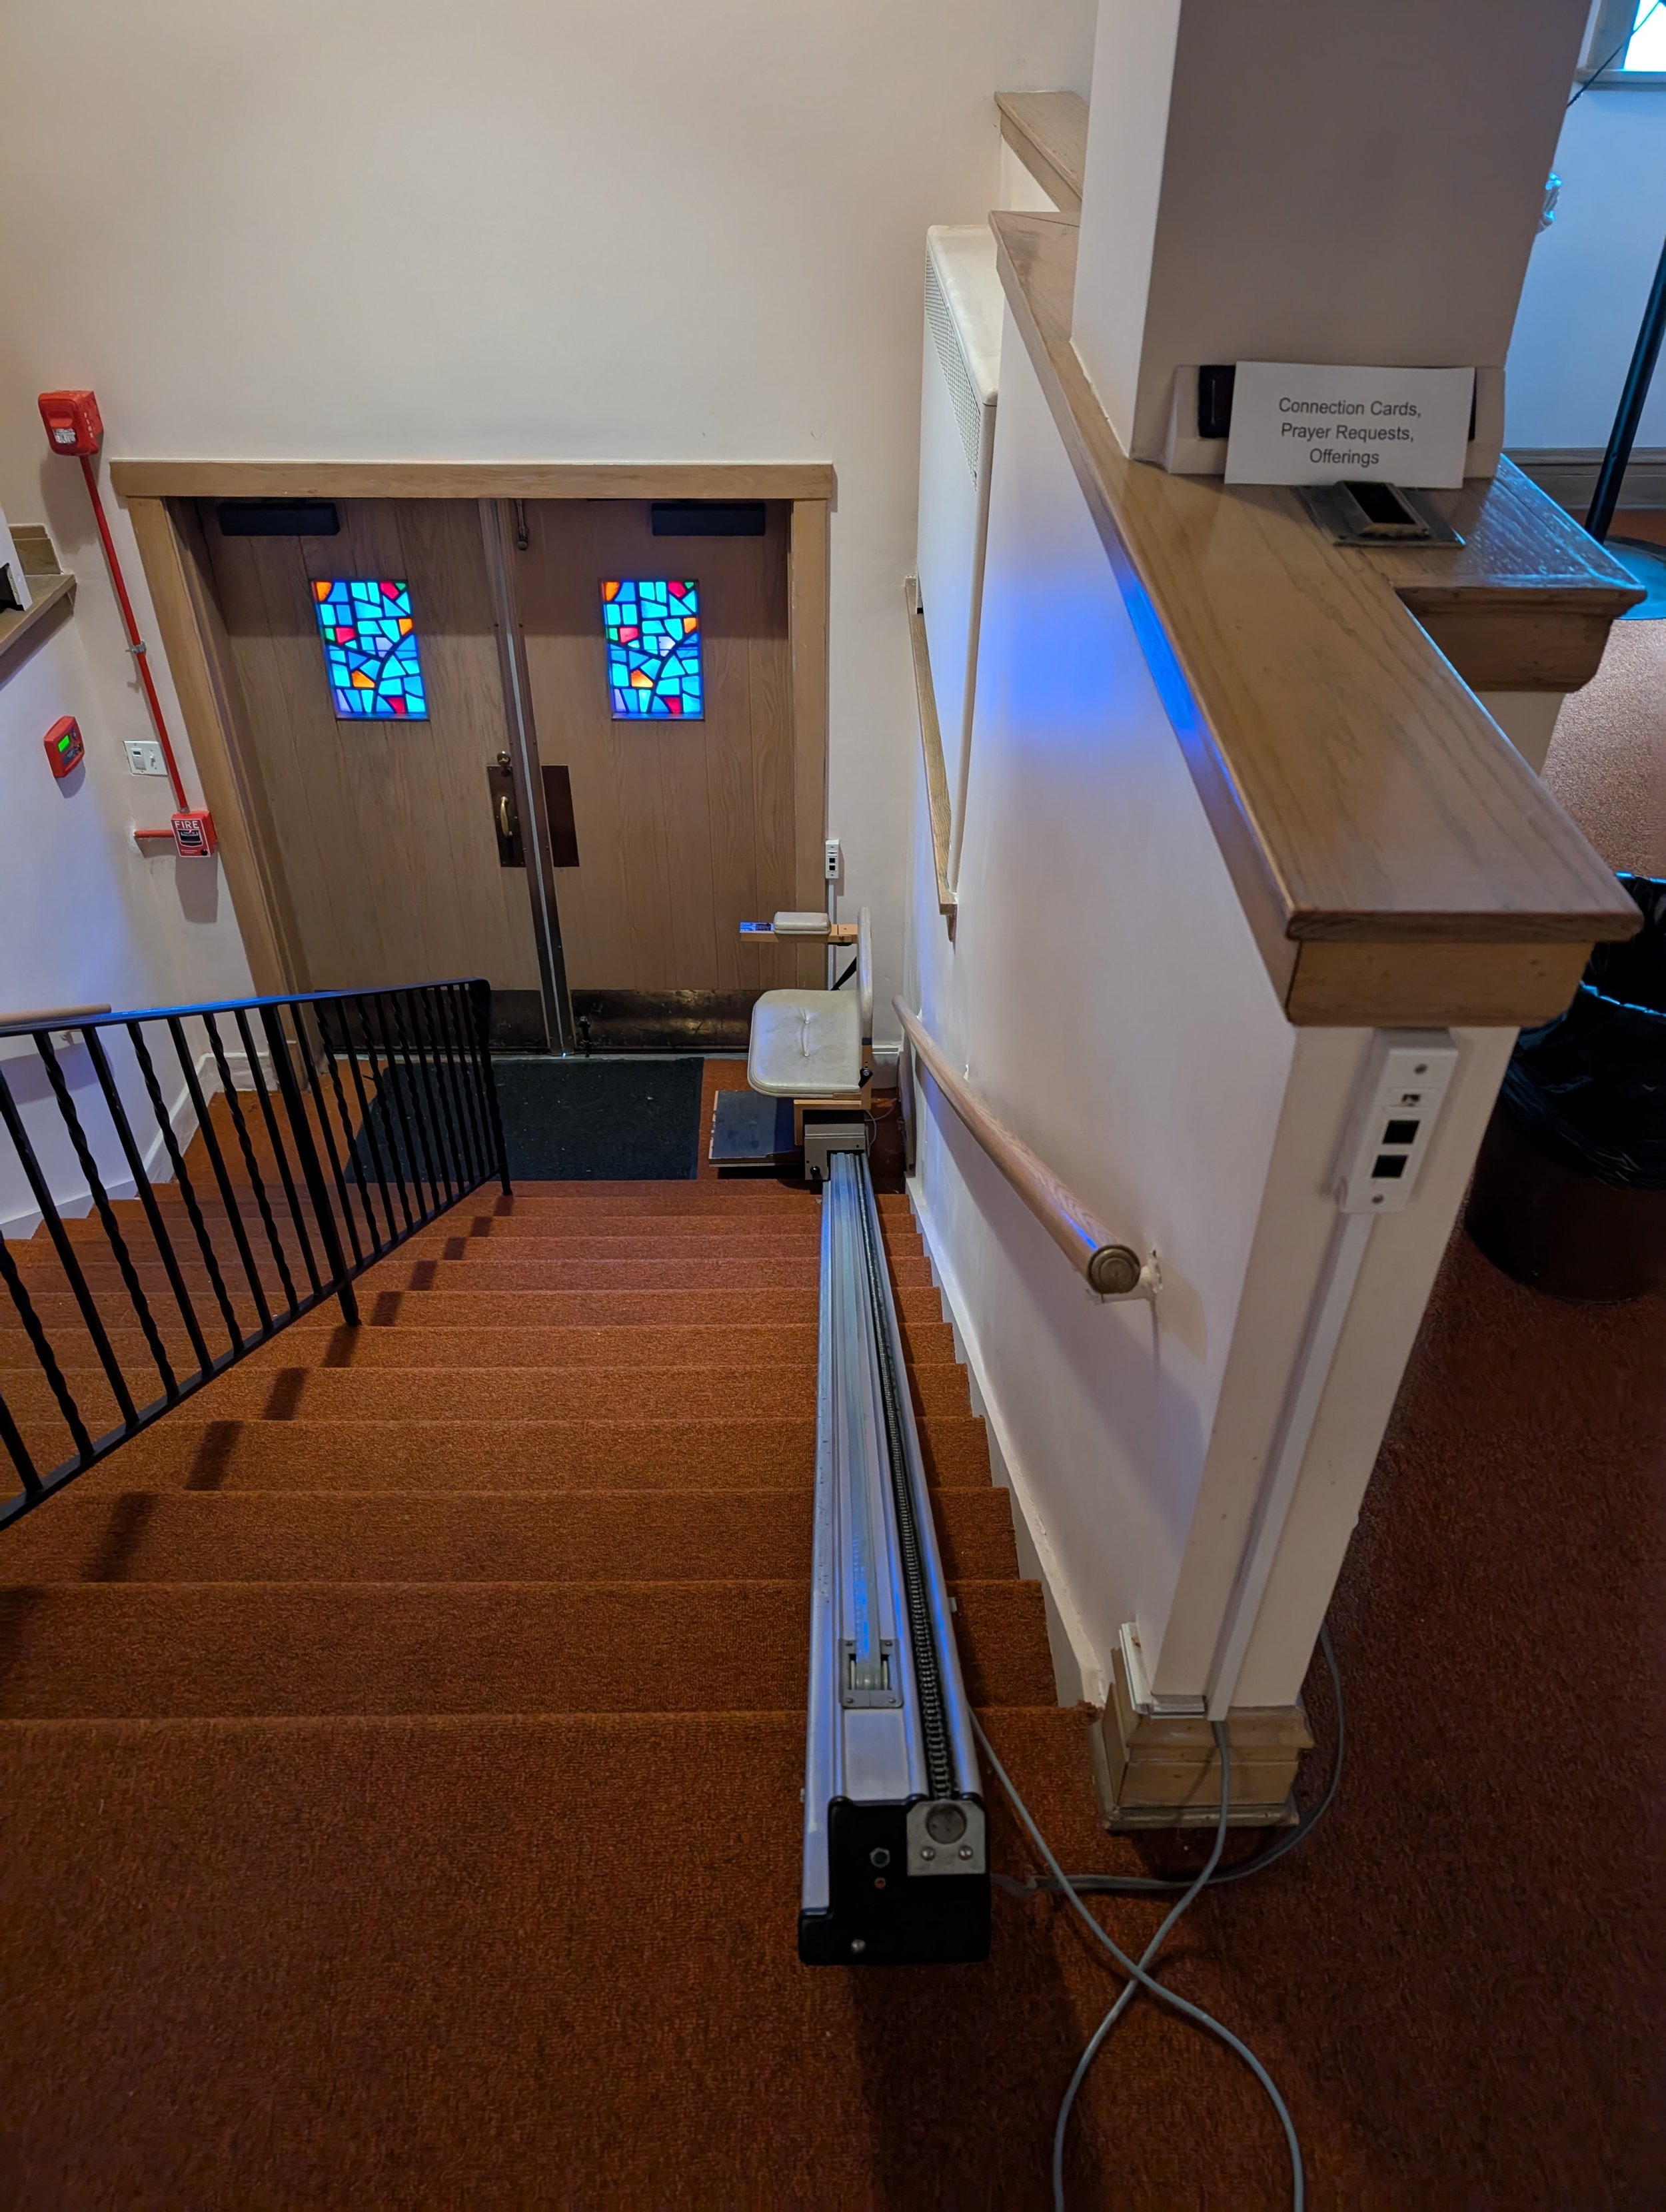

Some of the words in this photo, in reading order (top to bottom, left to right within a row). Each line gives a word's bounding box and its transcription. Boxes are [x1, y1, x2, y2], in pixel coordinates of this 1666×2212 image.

[1279, 397, 1364, 415] Connection
[1370, 400, 1421, 418] Cards,
[1281, 422, 1331, 442] Prayer
[1335, 424, 1413, 443] Requests,
[1309, 448, 1379, 468] Offerings
[174, 820, 200, 829] FIRE
